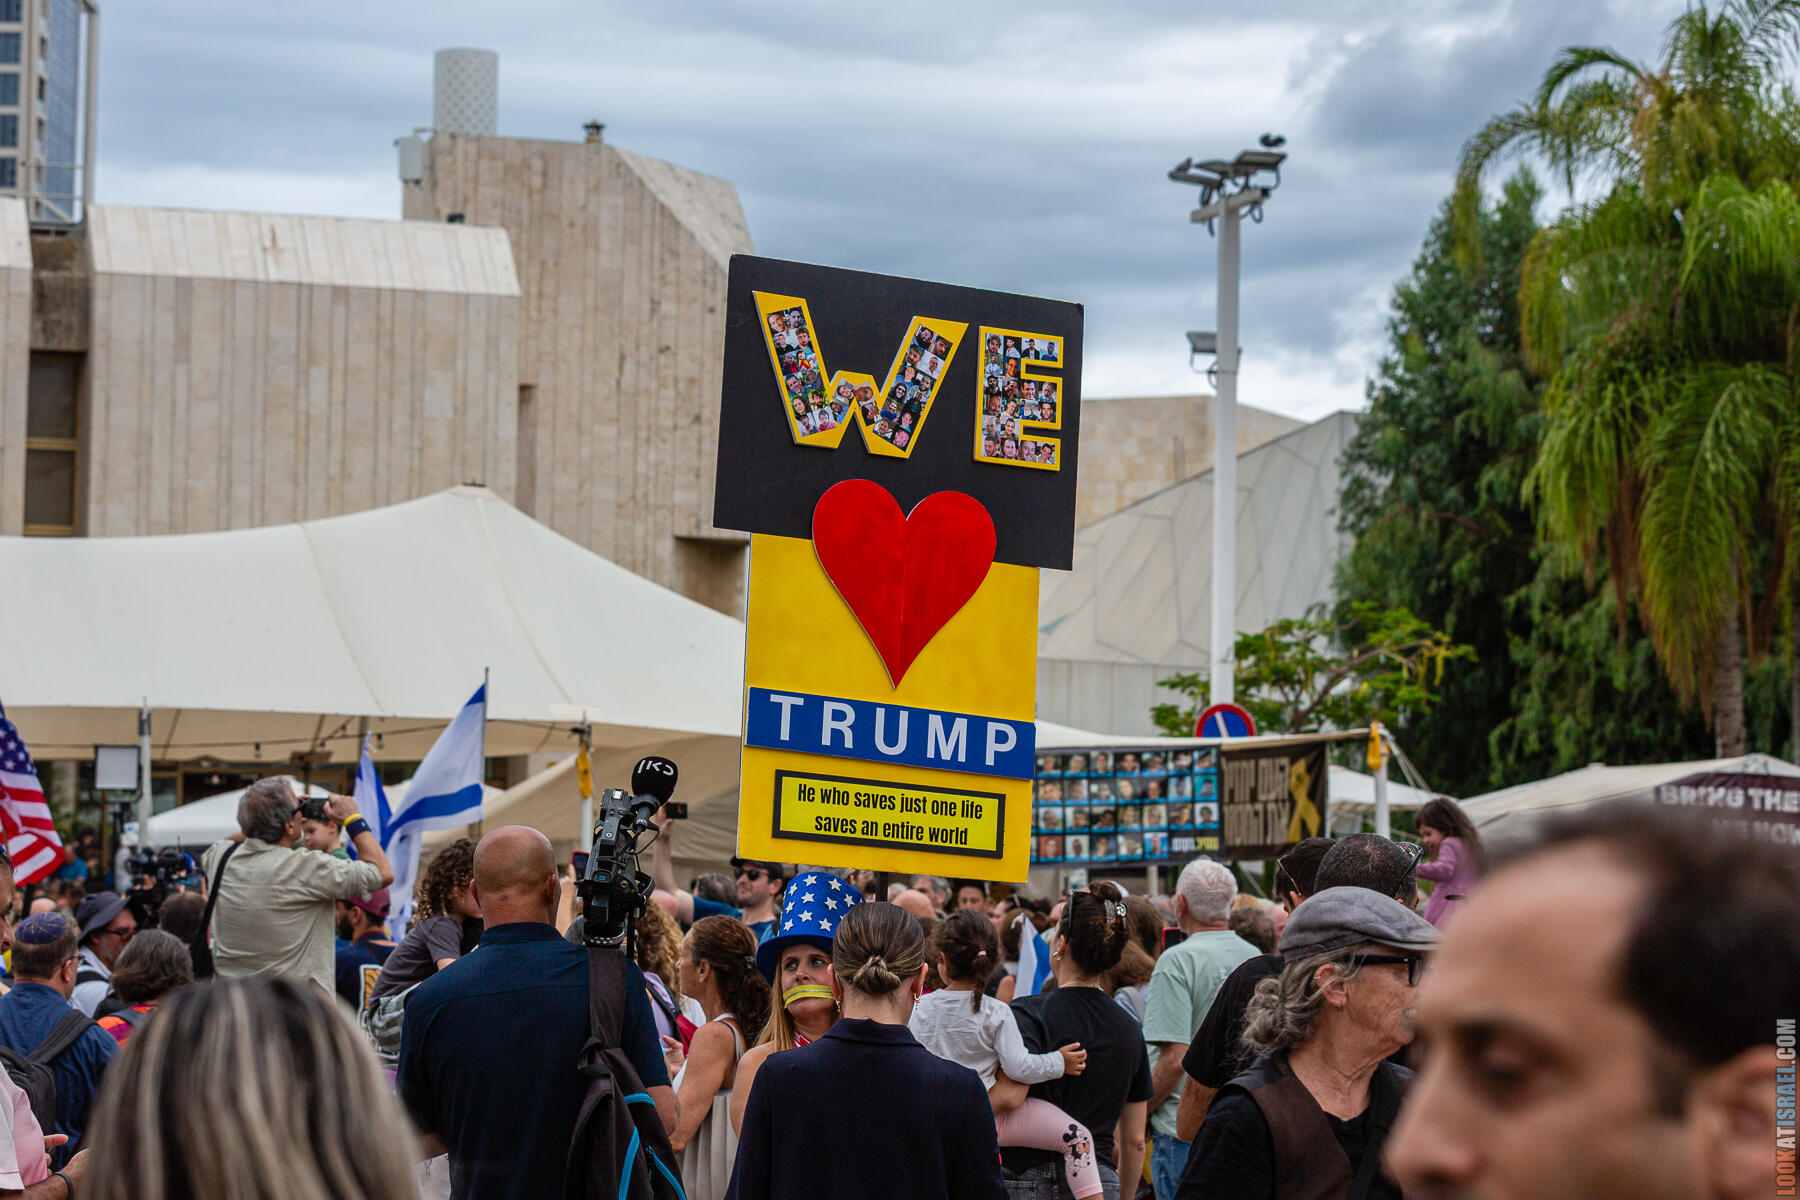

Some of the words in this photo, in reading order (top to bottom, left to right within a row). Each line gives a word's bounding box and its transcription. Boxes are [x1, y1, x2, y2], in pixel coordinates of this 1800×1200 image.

[752, 290, 1064, 471] WE
[770, 694, 1018, 766] TRUMP
[637, 760, 675, 776] כאן
[797, 783, 816, 803] He
[820, 786, 850, 806] who
[853, 791, 896, 811] saves
[899, 793, 928, 814] just
[931, 799, 957, 817] one
[960, 799, 983, 819] life
[1660, 784, 1745, 808] BRING
[814, 815, 858, 835] saves
[861, 820, 879, 837] an
[882, 821, 924, 841] entire
[928, 826, 968, 846] world
